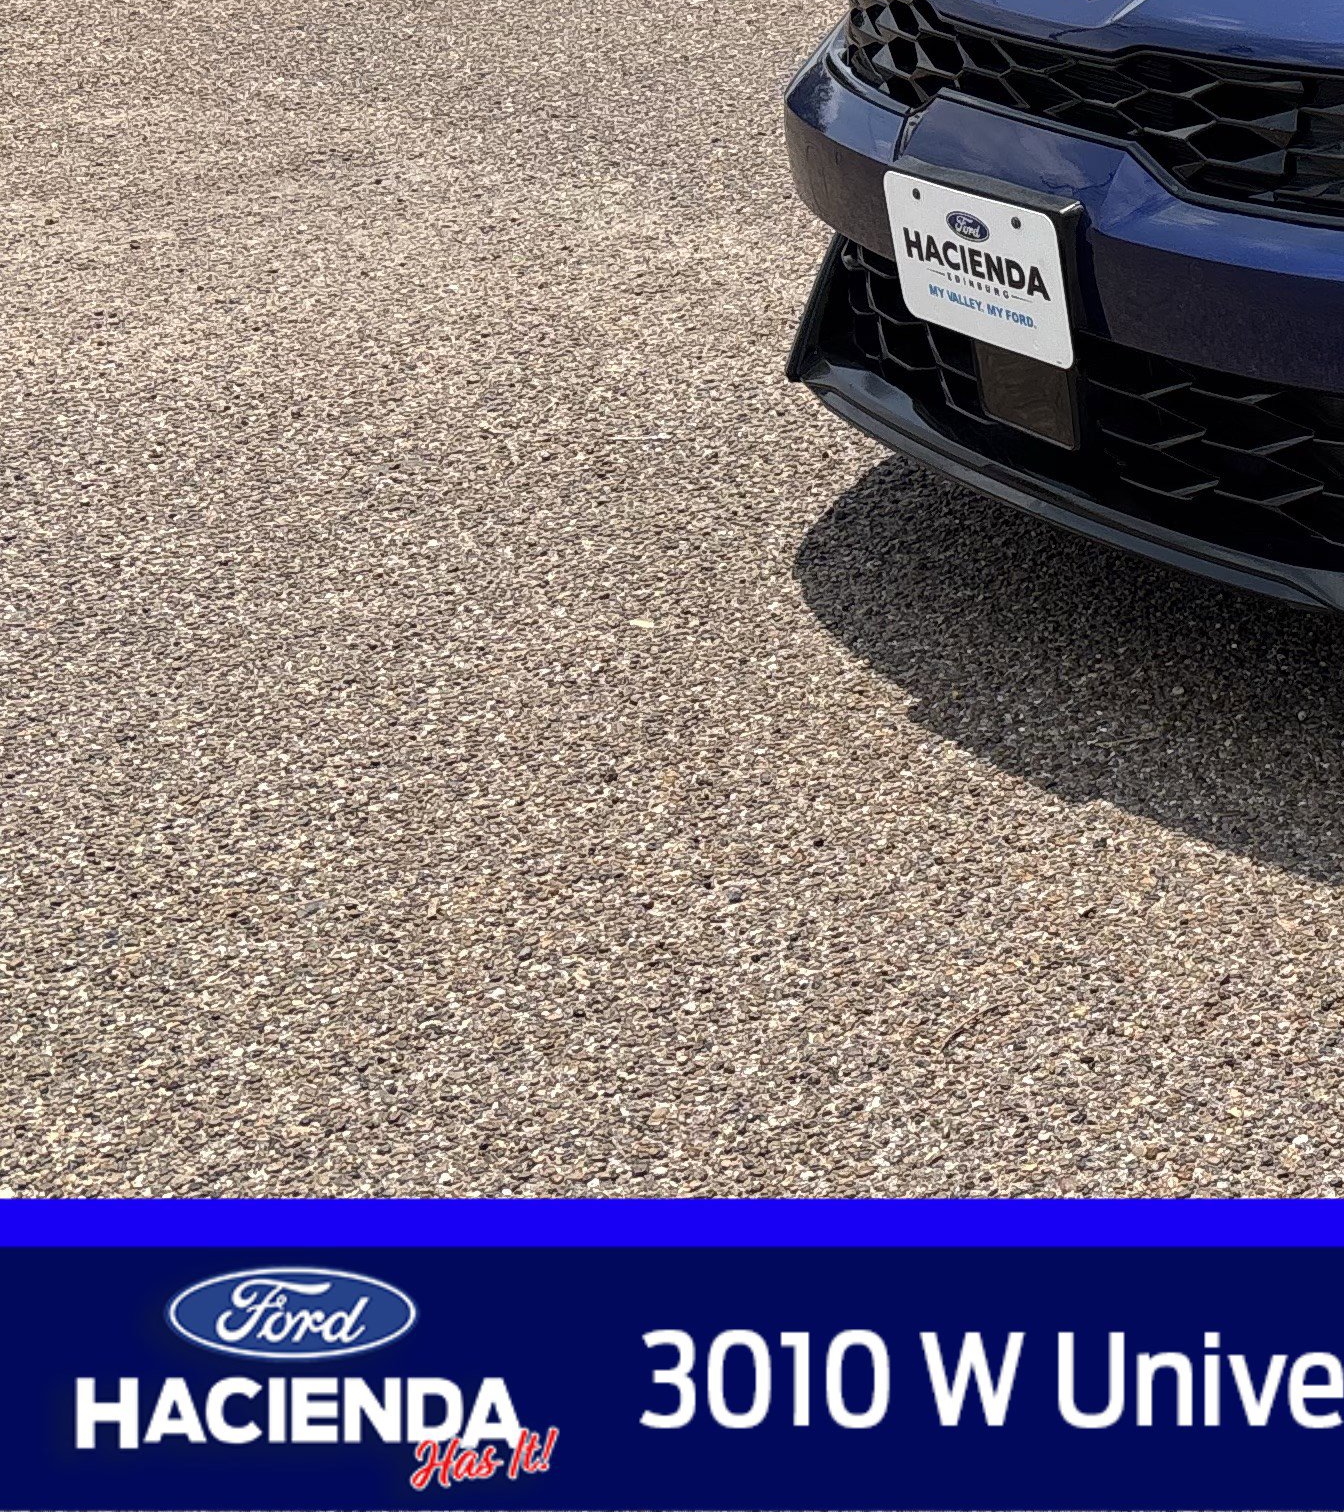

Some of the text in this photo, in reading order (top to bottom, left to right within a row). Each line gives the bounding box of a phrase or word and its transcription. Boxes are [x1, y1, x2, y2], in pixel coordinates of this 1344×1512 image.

[954, 215, 981, 238] Ford
[903, 227, 1051, 301] HACIENDA
[947, 272, 1010, 299] EDINBURG
[929, 284, 944, 298] MY
[987, 303, 1004, 319] MY
